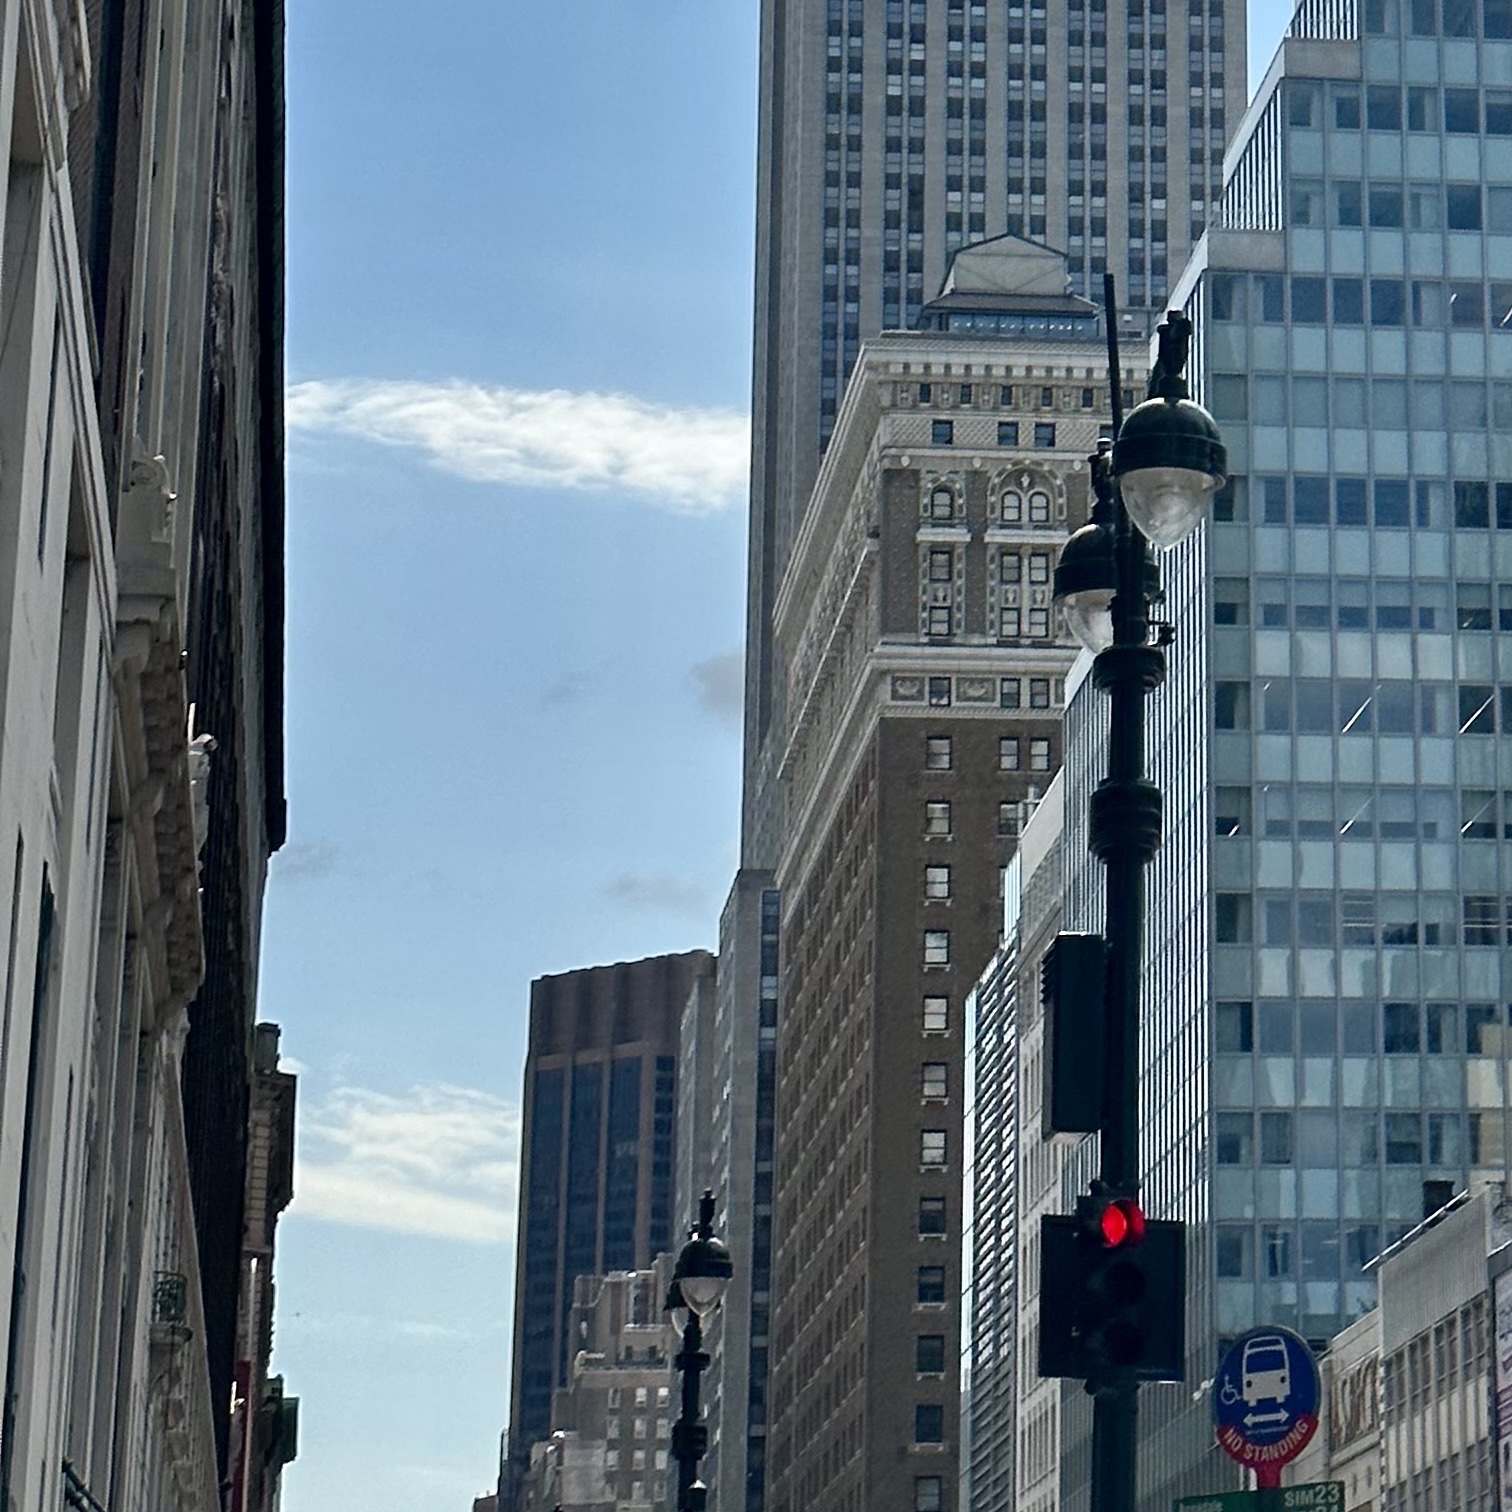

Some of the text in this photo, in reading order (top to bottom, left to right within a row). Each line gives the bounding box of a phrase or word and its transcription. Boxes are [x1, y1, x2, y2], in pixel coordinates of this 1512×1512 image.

[1223, 1419, 1309, 1462] NO STANDING
[1284, 1484, 1341, 1507] SIM23
